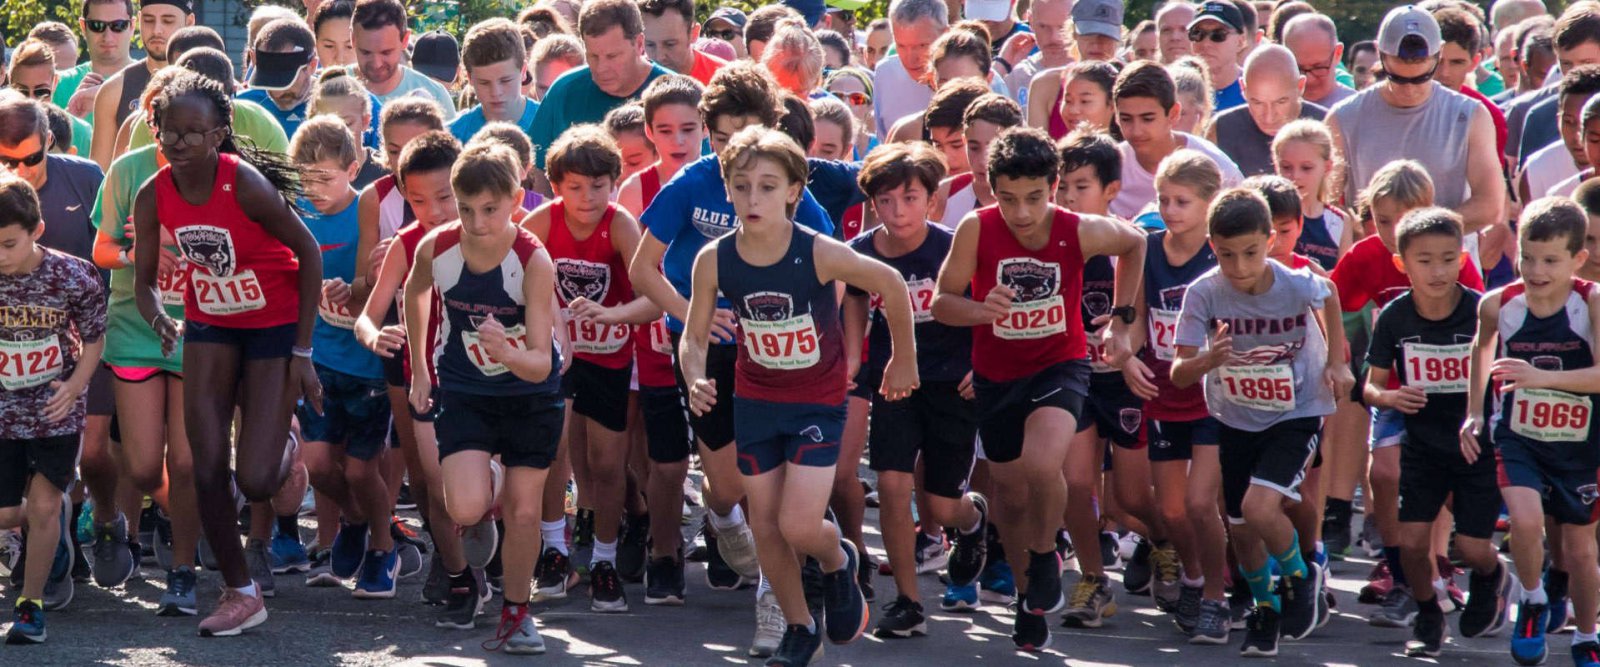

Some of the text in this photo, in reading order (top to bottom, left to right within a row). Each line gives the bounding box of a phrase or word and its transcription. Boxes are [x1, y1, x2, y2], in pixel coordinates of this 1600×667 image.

[692, 206, 730, 226] BLUE
[196, 278, 261, 304] 2115
[996, 305, 1063, 330] 2020
[567, 318, 627, 343] 1973
[652, 322, 672, 345] 1
[747, 326, 816, 357] 1975
[0, 346, 61, 377] 2122
[1223, 377, 1292, 402] 1895
[1516, 399, 1589, 429] 1969
